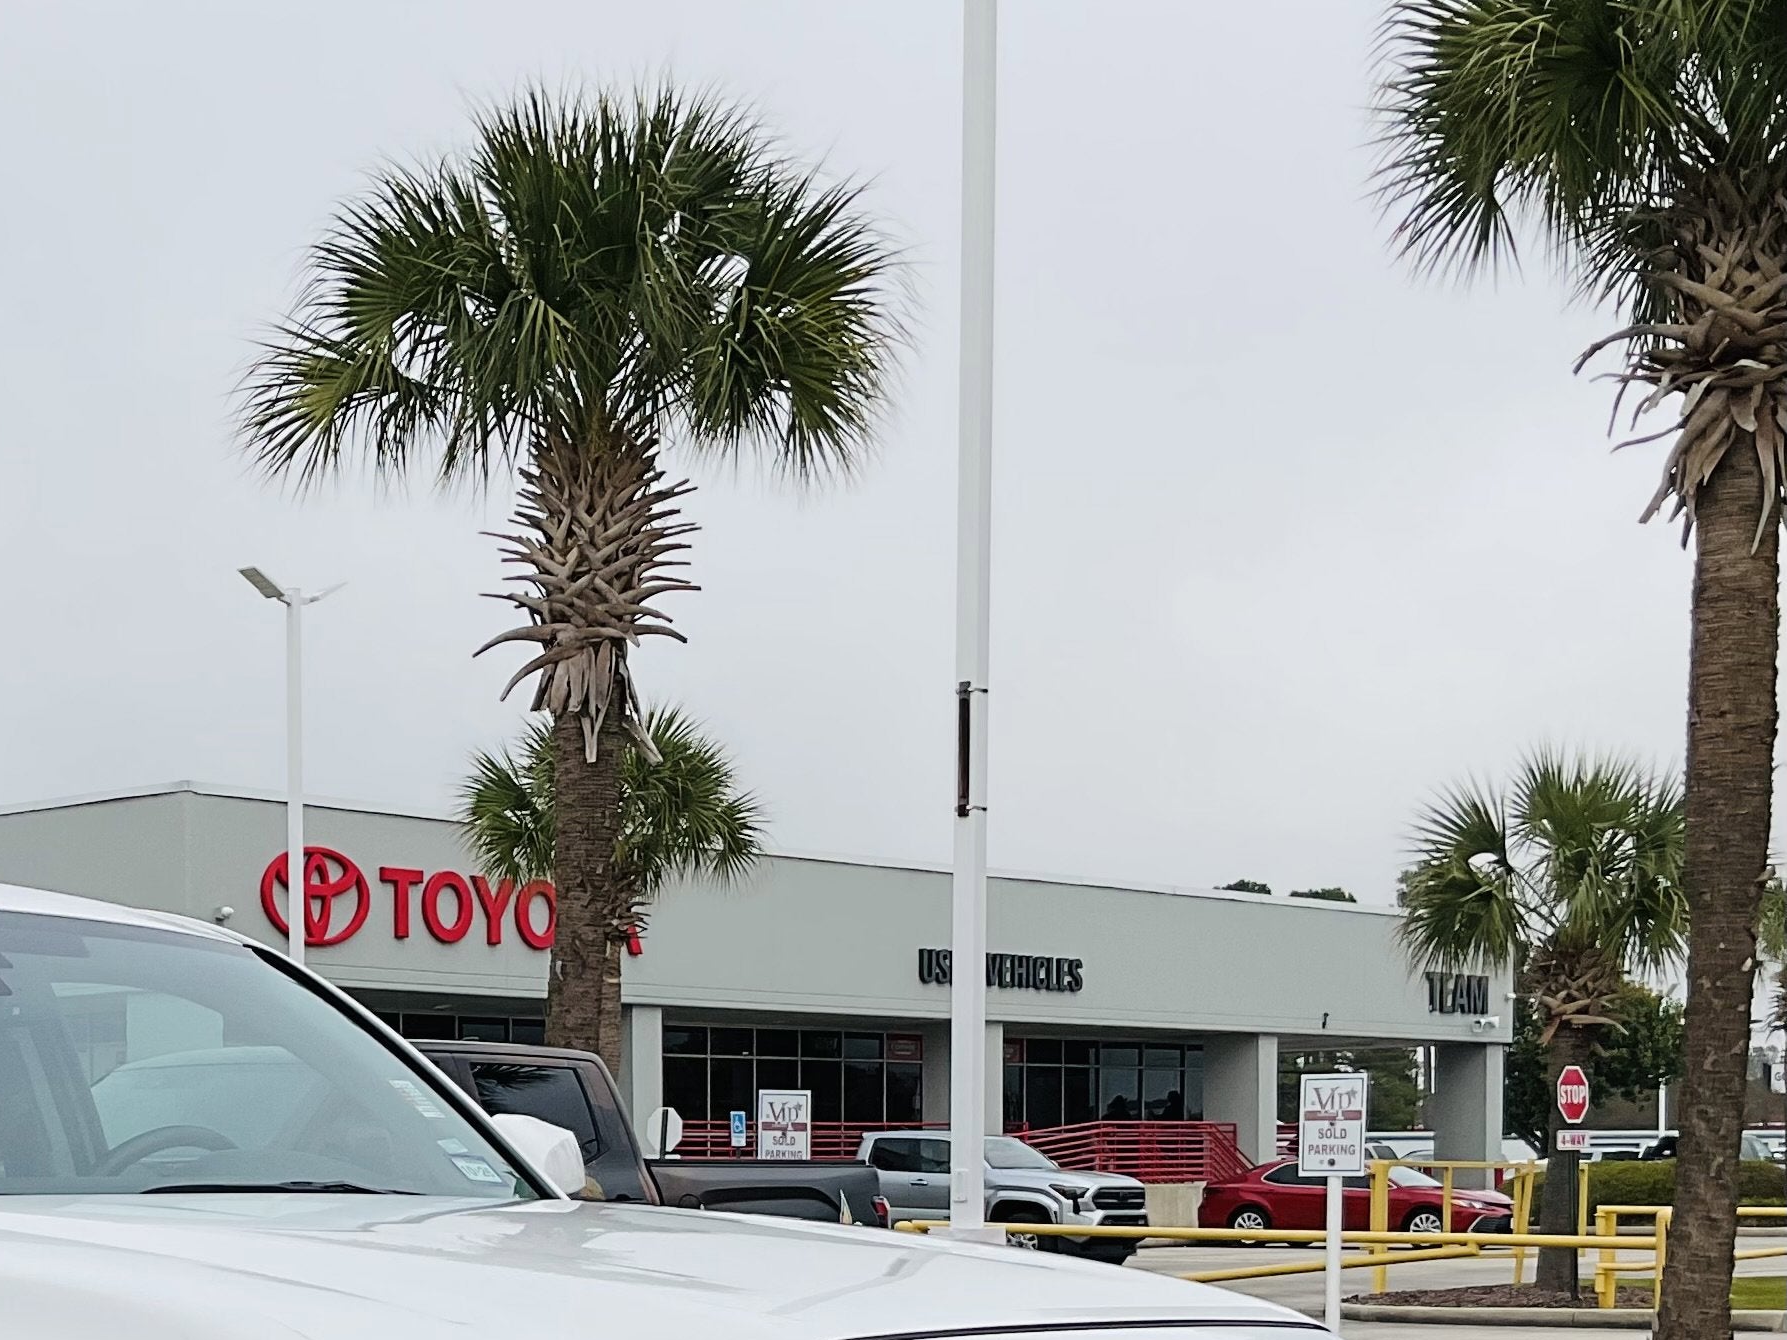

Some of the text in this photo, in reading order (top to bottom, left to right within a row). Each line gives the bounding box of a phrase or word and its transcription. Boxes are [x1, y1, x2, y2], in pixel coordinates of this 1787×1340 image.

[379, 866, 643, 957] TOYO
[918, 948, 1084, 993] US VEHICLES
[1425, 971, 1489, 1015] TEAM
[1560, 1085, 1586, 1104] STOP
[1318, 1128, 1347, 1139] SOLD
[772, 1136, 796, 1146] SOLD
[1561, 1134, 1586, 1146] 4-WAY
[765, 1149, 803, 1160] PARKING
[1308, 1144, 1356, 1156] PARKING
